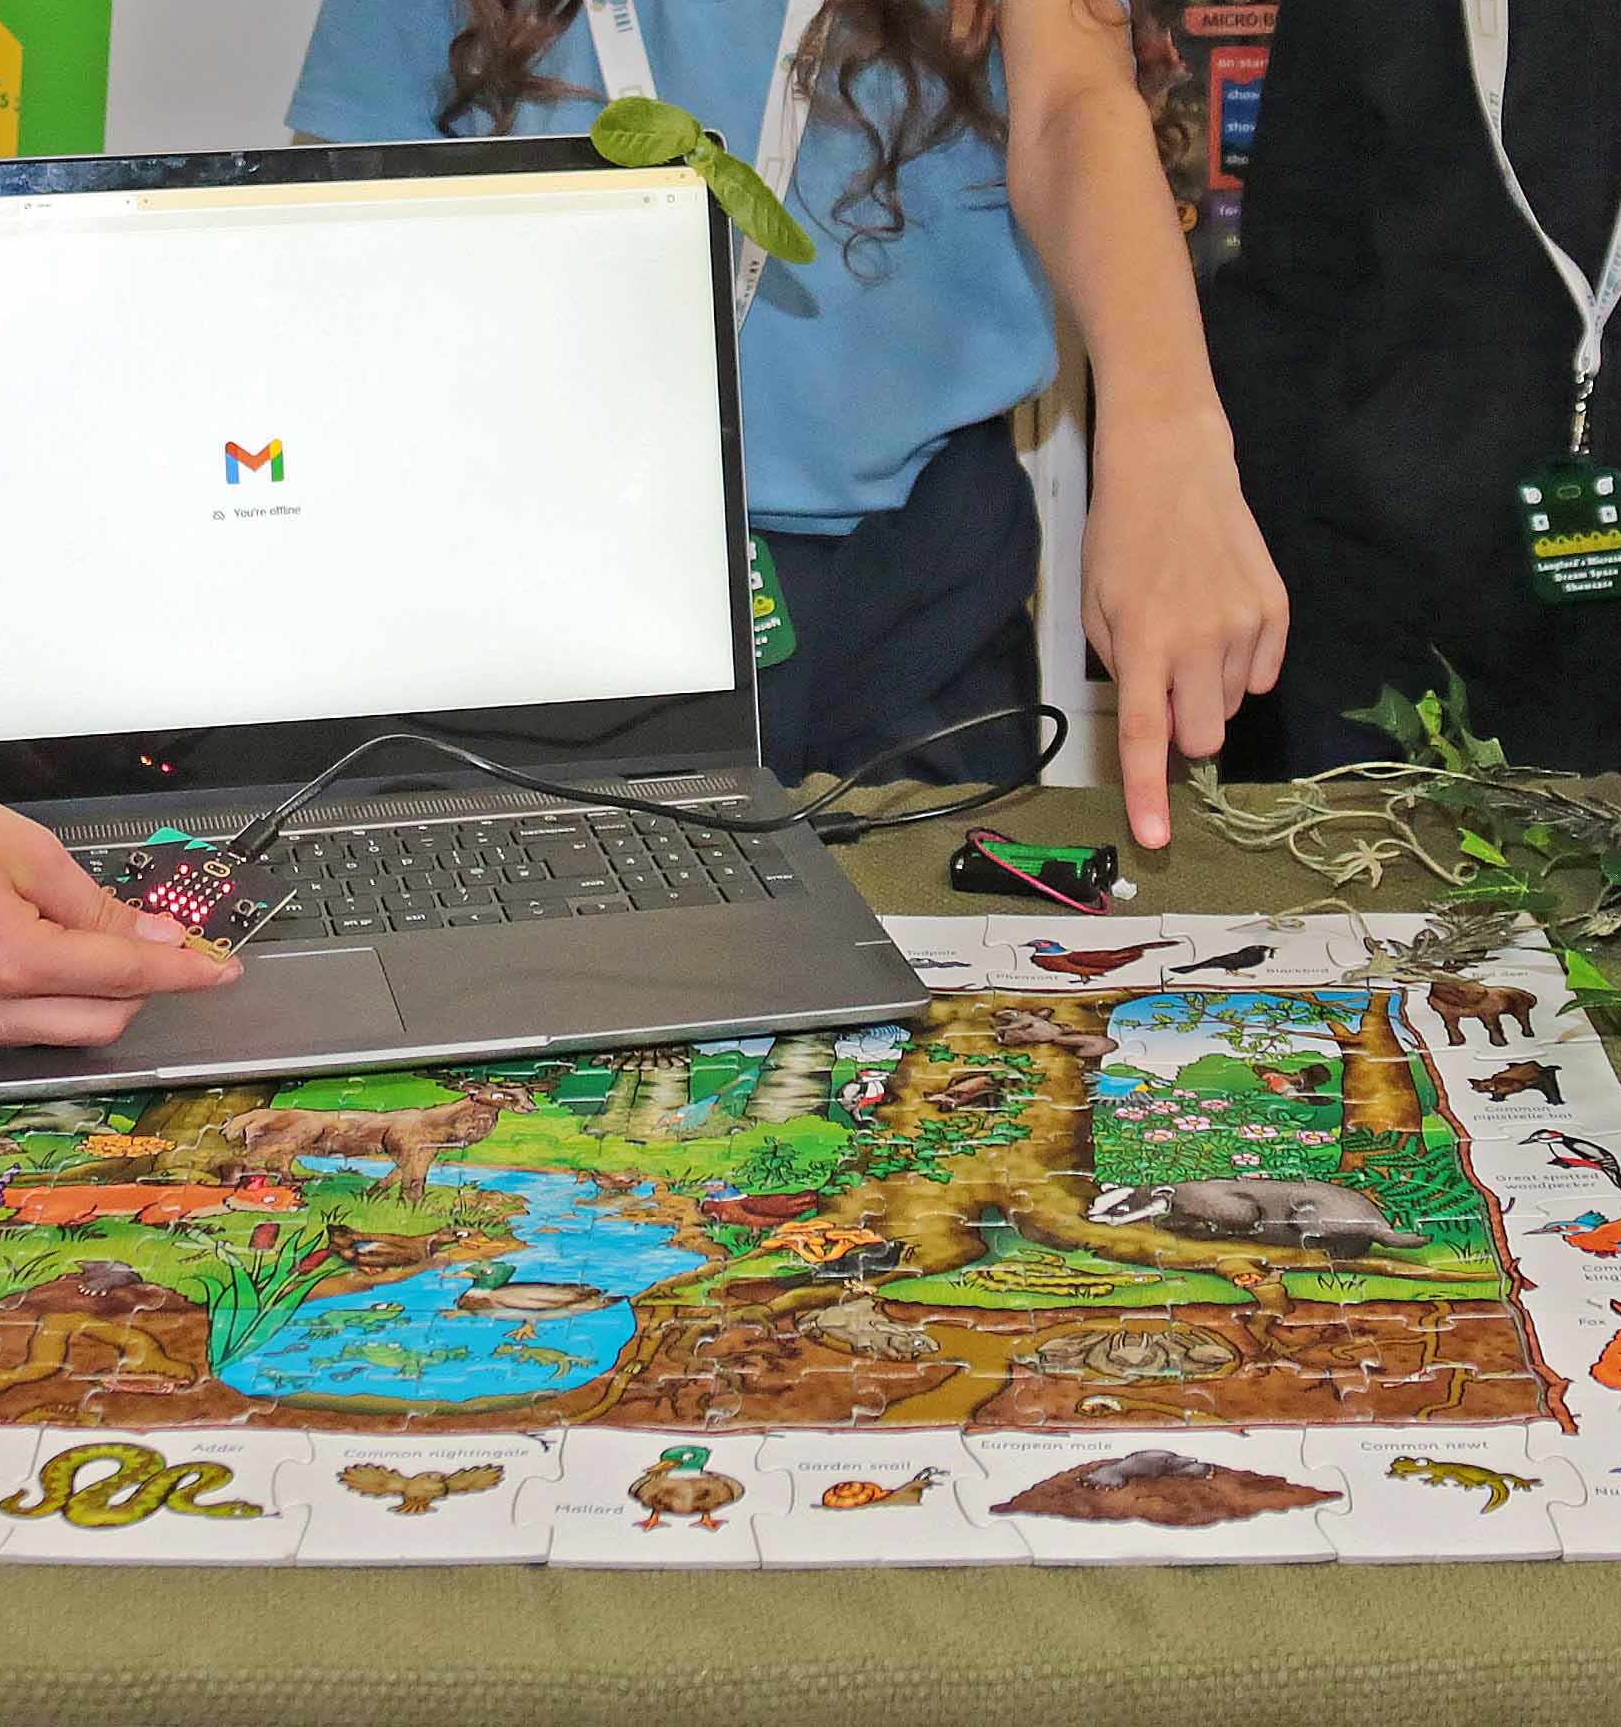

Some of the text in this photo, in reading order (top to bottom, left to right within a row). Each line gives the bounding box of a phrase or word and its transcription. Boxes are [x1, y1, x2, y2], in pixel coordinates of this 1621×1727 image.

[234, 505, 301, 519] You're offline
[342, 1446, 530, 1463] Common nightingale
[798, 1459, 913, 1473] Garden snail
[554, 1502, 624, 1517] Mallard
